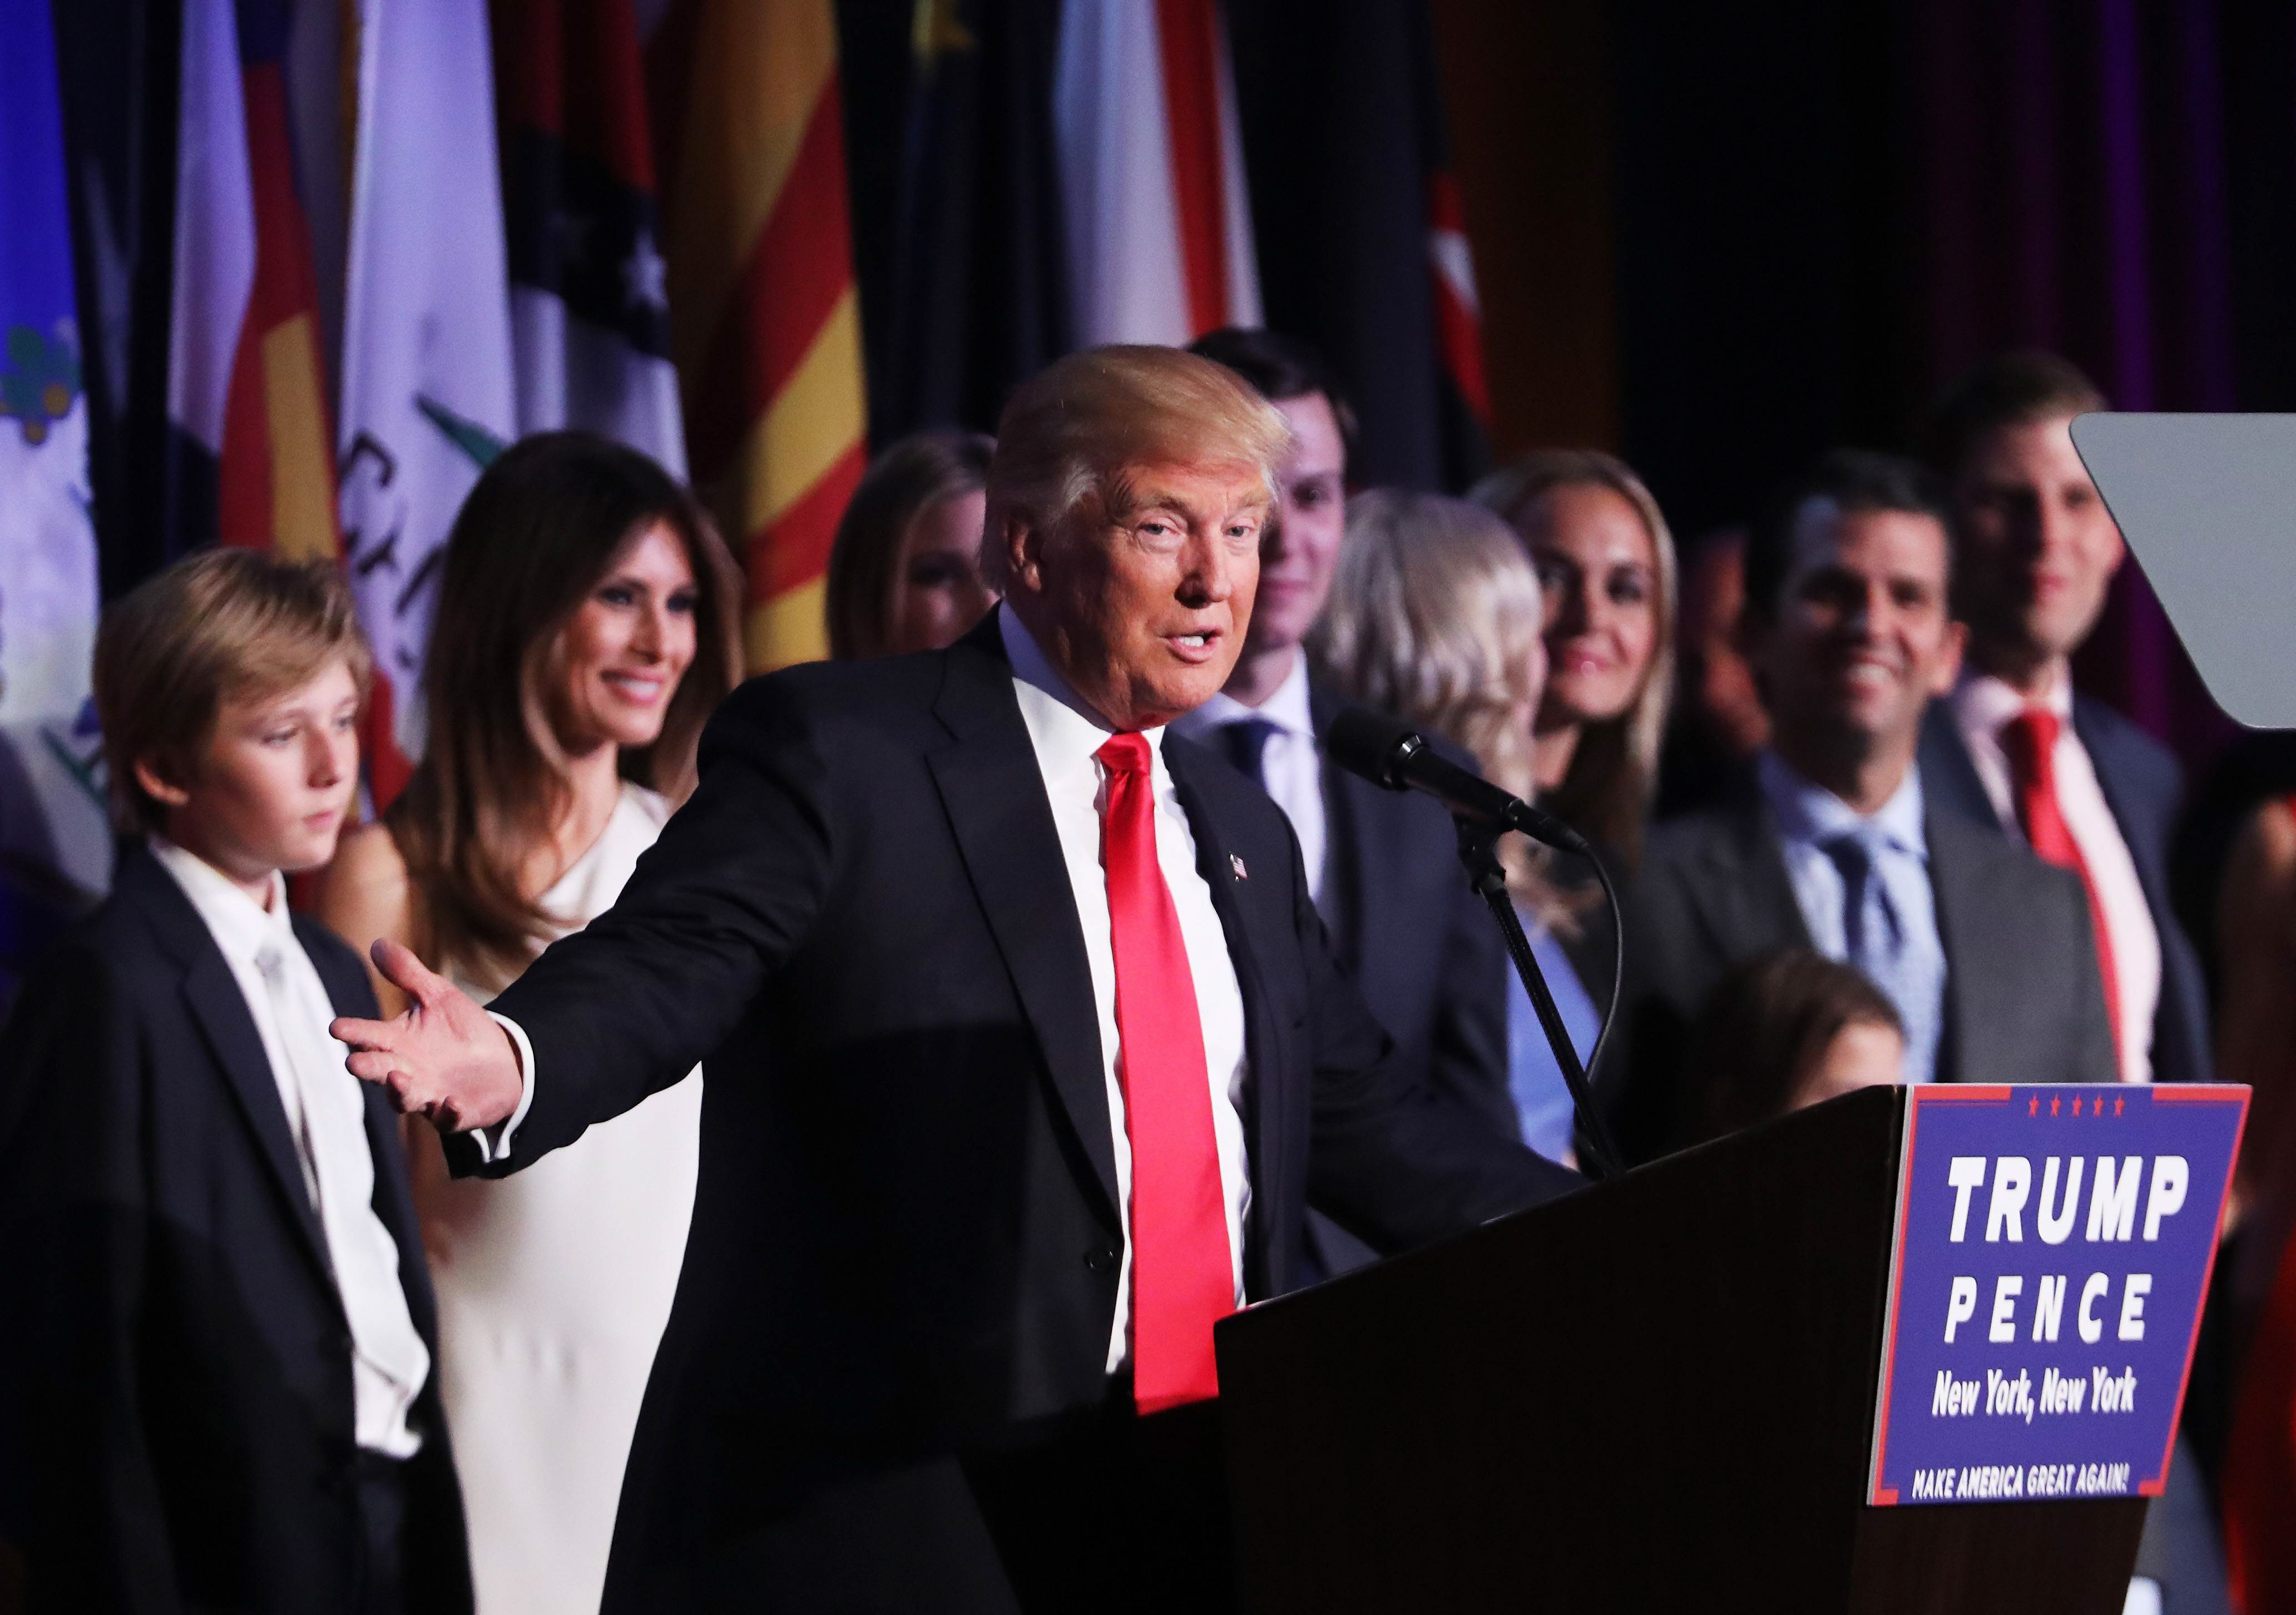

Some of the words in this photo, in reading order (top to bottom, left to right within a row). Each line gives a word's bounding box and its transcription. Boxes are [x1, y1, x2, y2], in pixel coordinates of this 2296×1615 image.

[1947, 1155, 2190, 1245] TRUMP
[1943, 1272, 2153, 1344] PENCE
[1932, 1370, 1981, 1417] New
[1985, 1368, 2035, 1425] York,
[2039, 1367, 2087, 1414] New
[2091, 1365, 2137, 1413] York
[1912, 1468, 1956, 1500] MAKE
[1956, 1465, 2023, 1499] AMERICA
[2027, 1464, 2076, 1496] GREAT
[2075, 1463, 2130, 1494] AGAIN!
